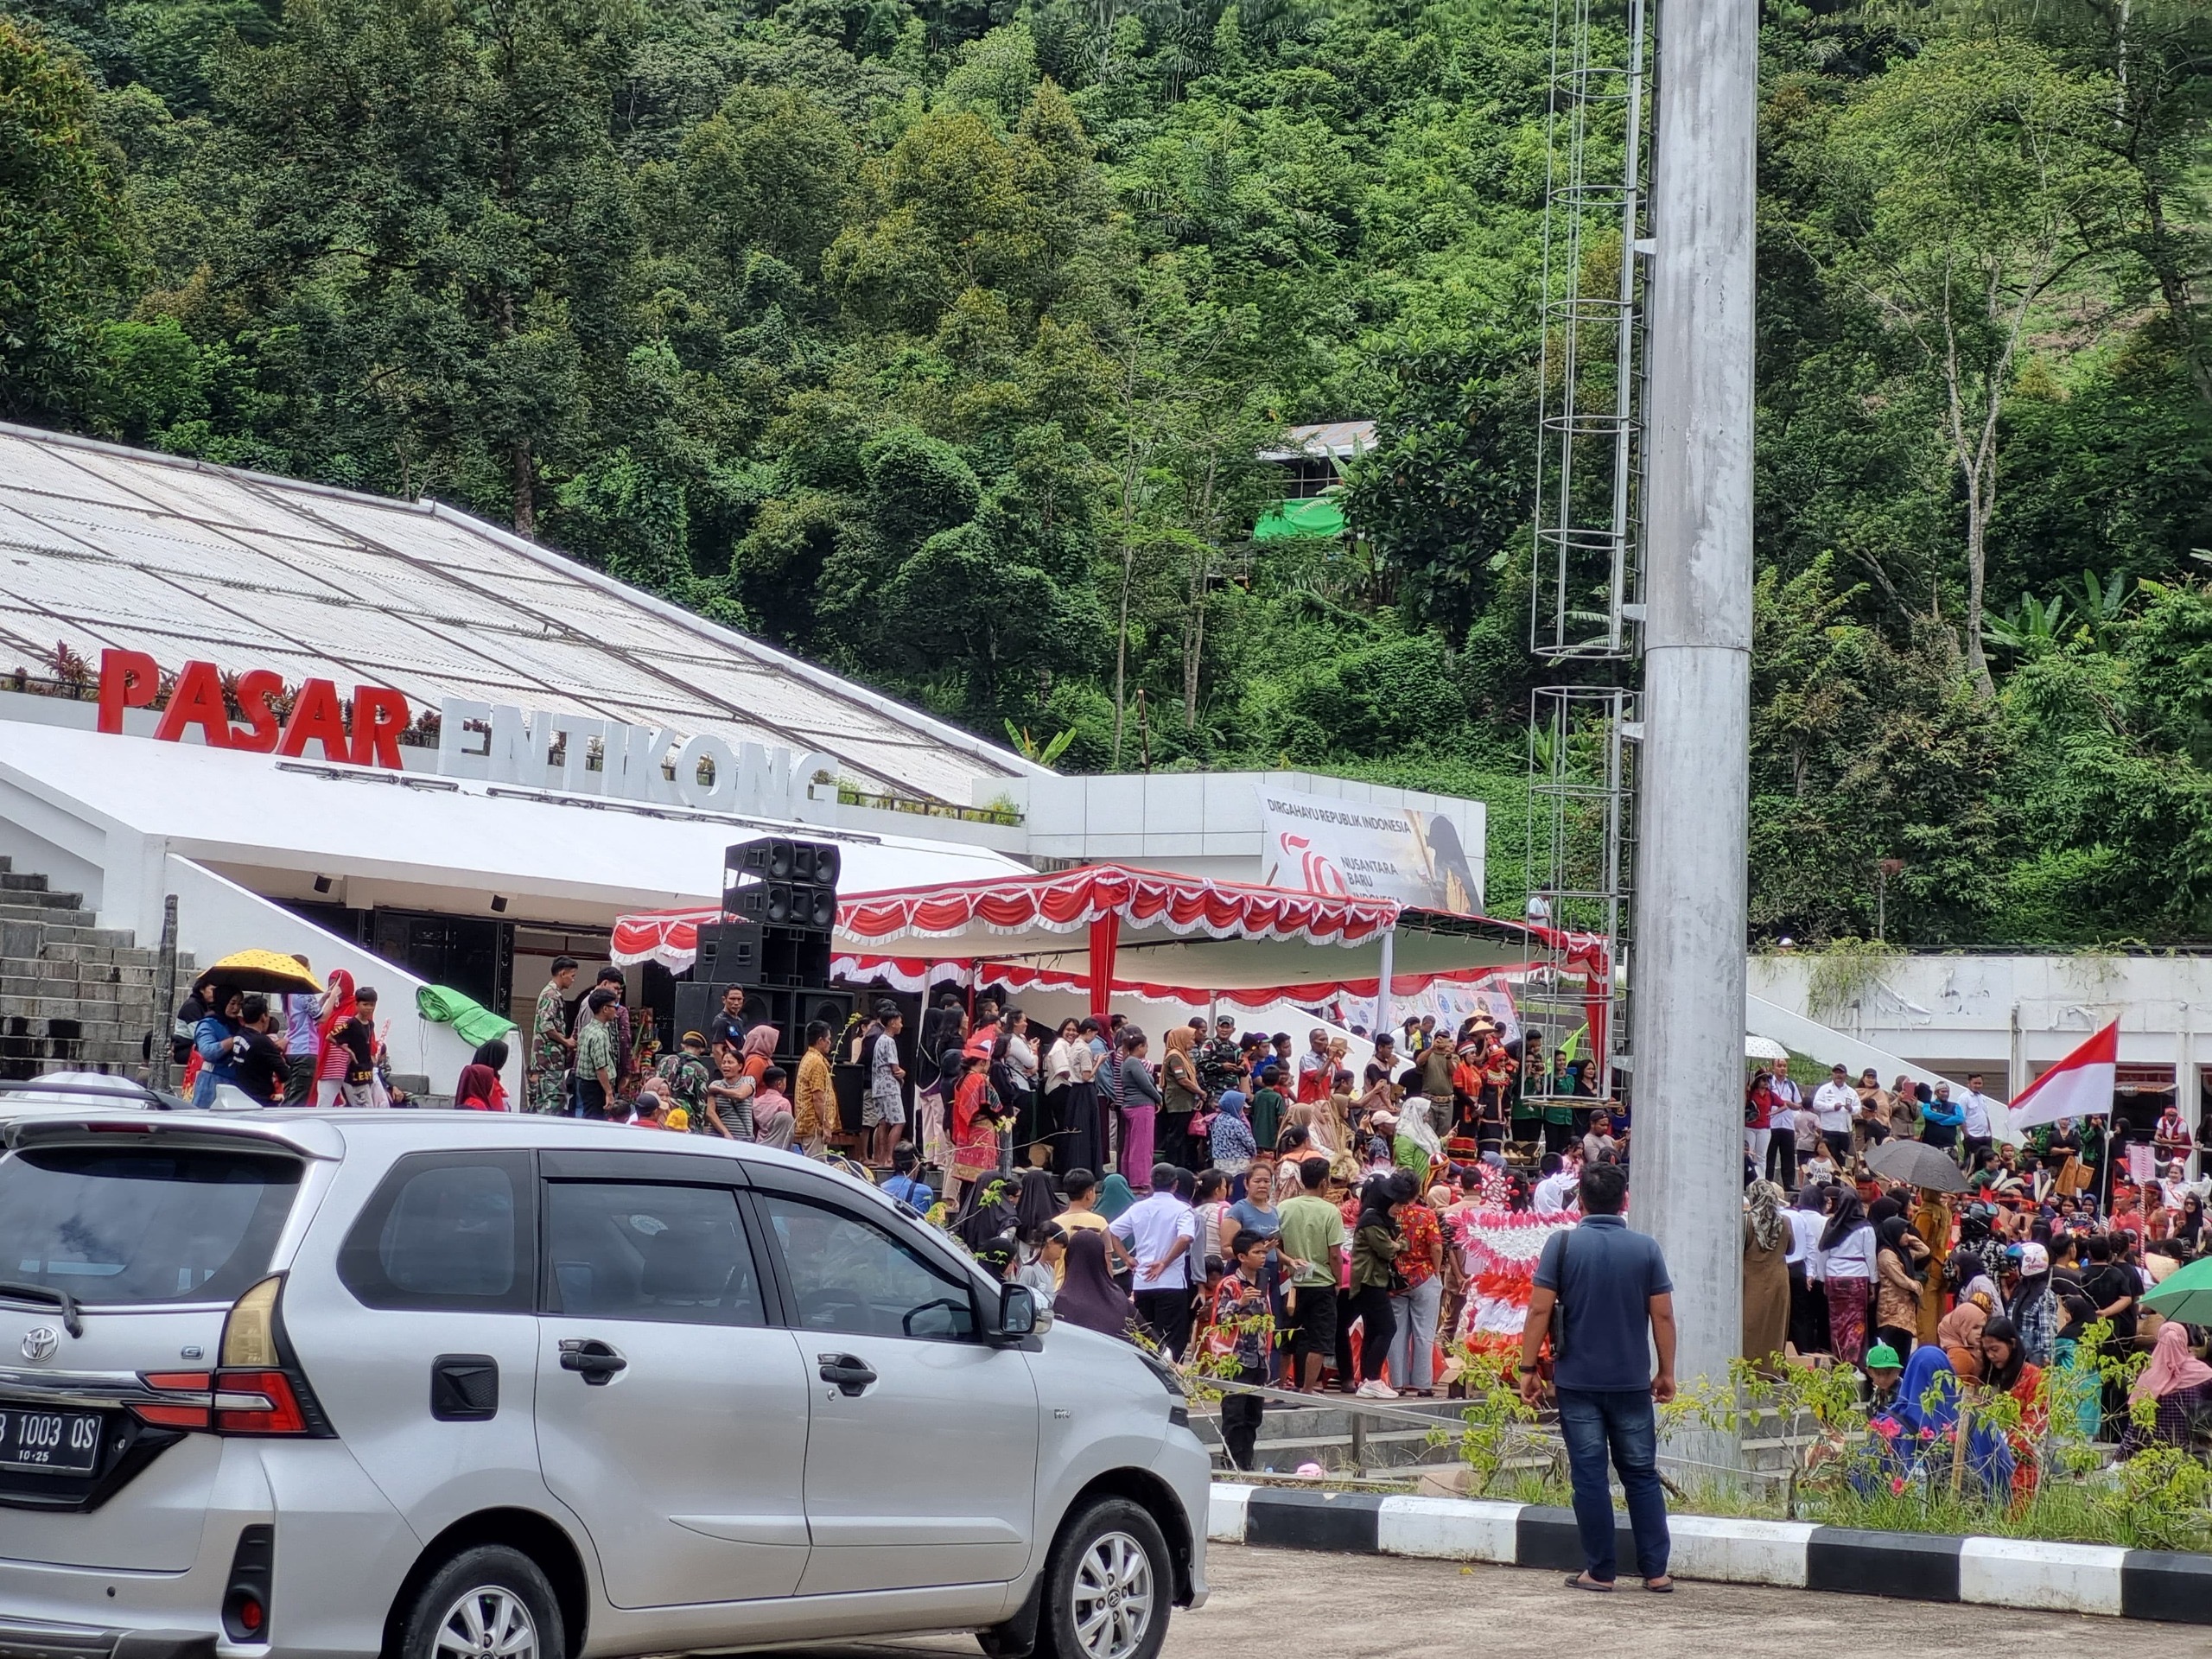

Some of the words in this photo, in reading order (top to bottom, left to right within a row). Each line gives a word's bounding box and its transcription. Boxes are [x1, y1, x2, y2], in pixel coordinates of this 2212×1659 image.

[97, 648, 409, 771] PASAR
[436, 696, 838, 826] ENTIKONG
[1267, 798, 1319, 821] DIRGAHAYU
[1319, 809, 1363, 828] REPUBLIK
[1362, 816, 1412, 834] INDONESIA
[1340, 856, 1399, 875] NUSANTARA
[1347, 872, 1373, 887] BARU
[18, 1414, 62, 1446] 1003
[71, 1418, 95, 1448] QS
